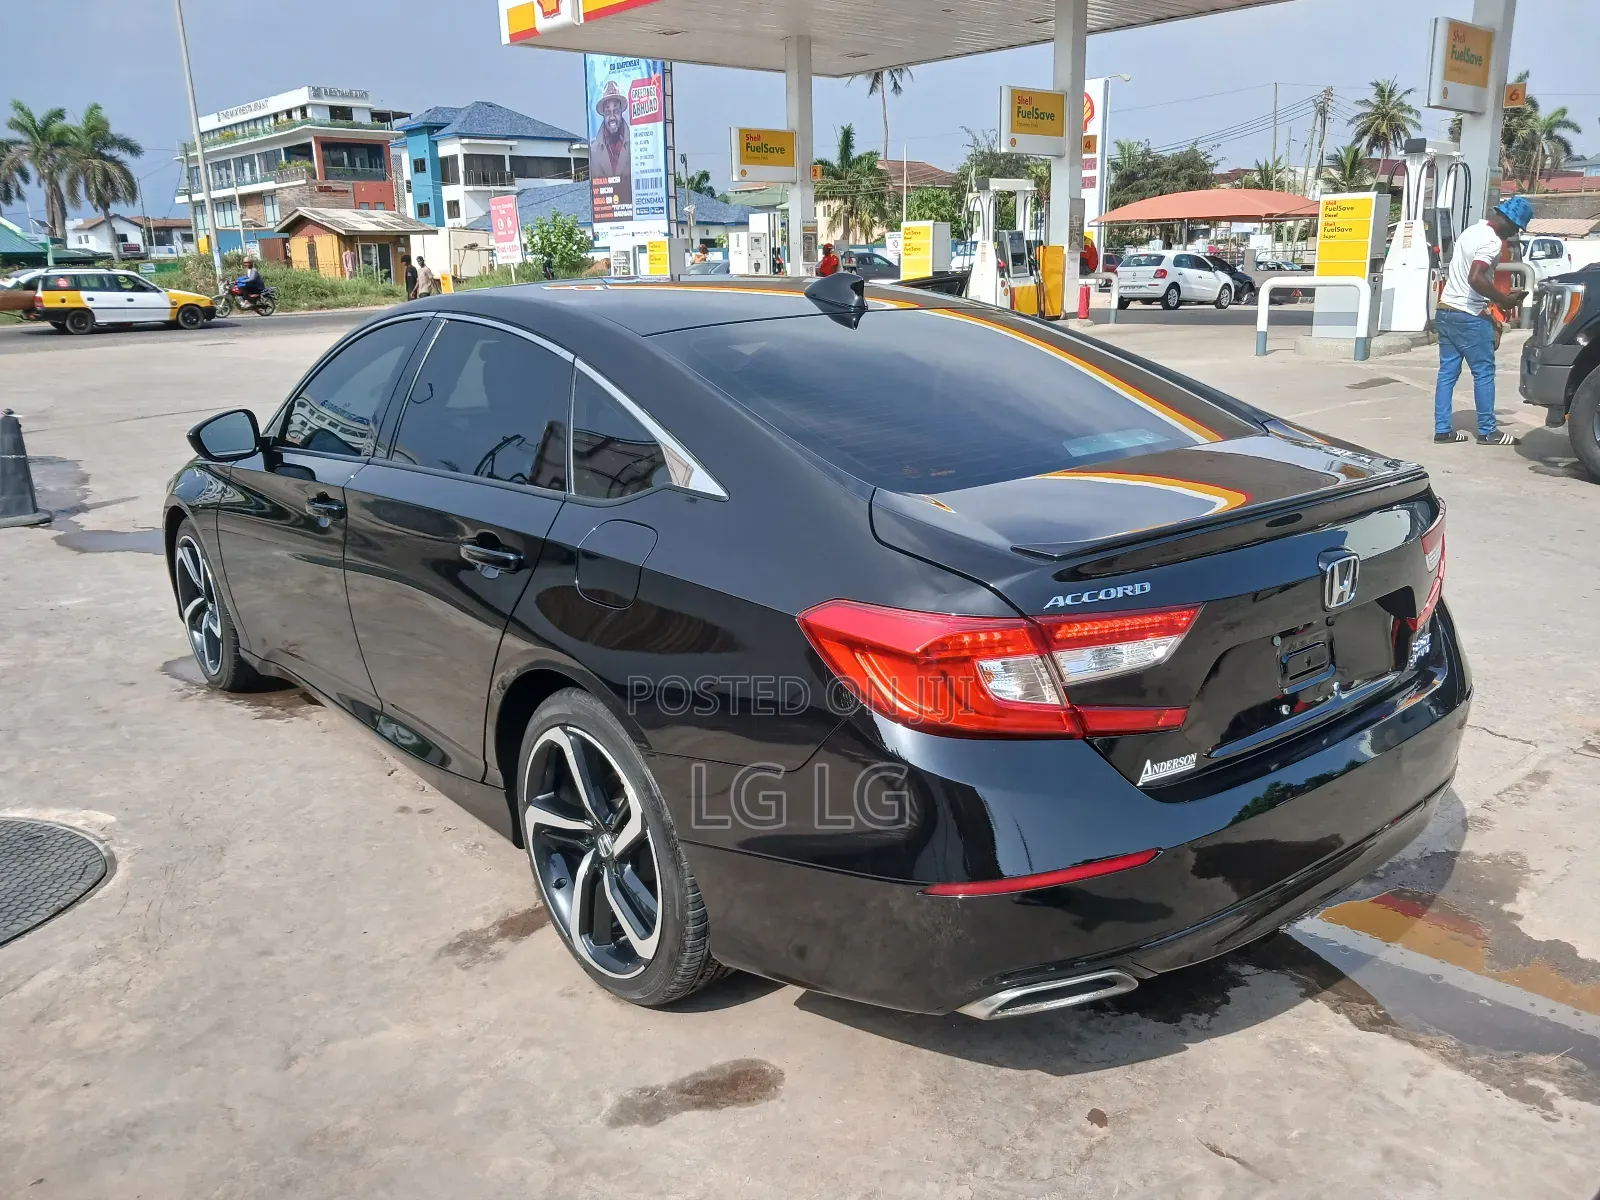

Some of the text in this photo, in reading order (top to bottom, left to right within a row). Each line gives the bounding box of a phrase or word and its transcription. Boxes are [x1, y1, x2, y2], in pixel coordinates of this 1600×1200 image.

[1453, 30, 1466, 43] Shell
[1450, 44, 1483, 66] FuelSave
[322, 88, 370, 97] RESTAURANT
[631, 87, 656, 98] GREETINGS
[1509, 89, 1520, 101] 6
[1017, 95, 1033, 105] Shell
[632, 98, 658, 117] ABROAD
[1016, 106, 1055, 121] FuelSave
[745, 133, 761, 141] Shell
[745, 142, 786, 154] FuelSave
[1084, 140, 1091, 149] 4
[812, 168, 817, 176] 2
[1043, 582, 1151, 611] ACCORD
[1136, 752, 1198, 786] ANDERSON
